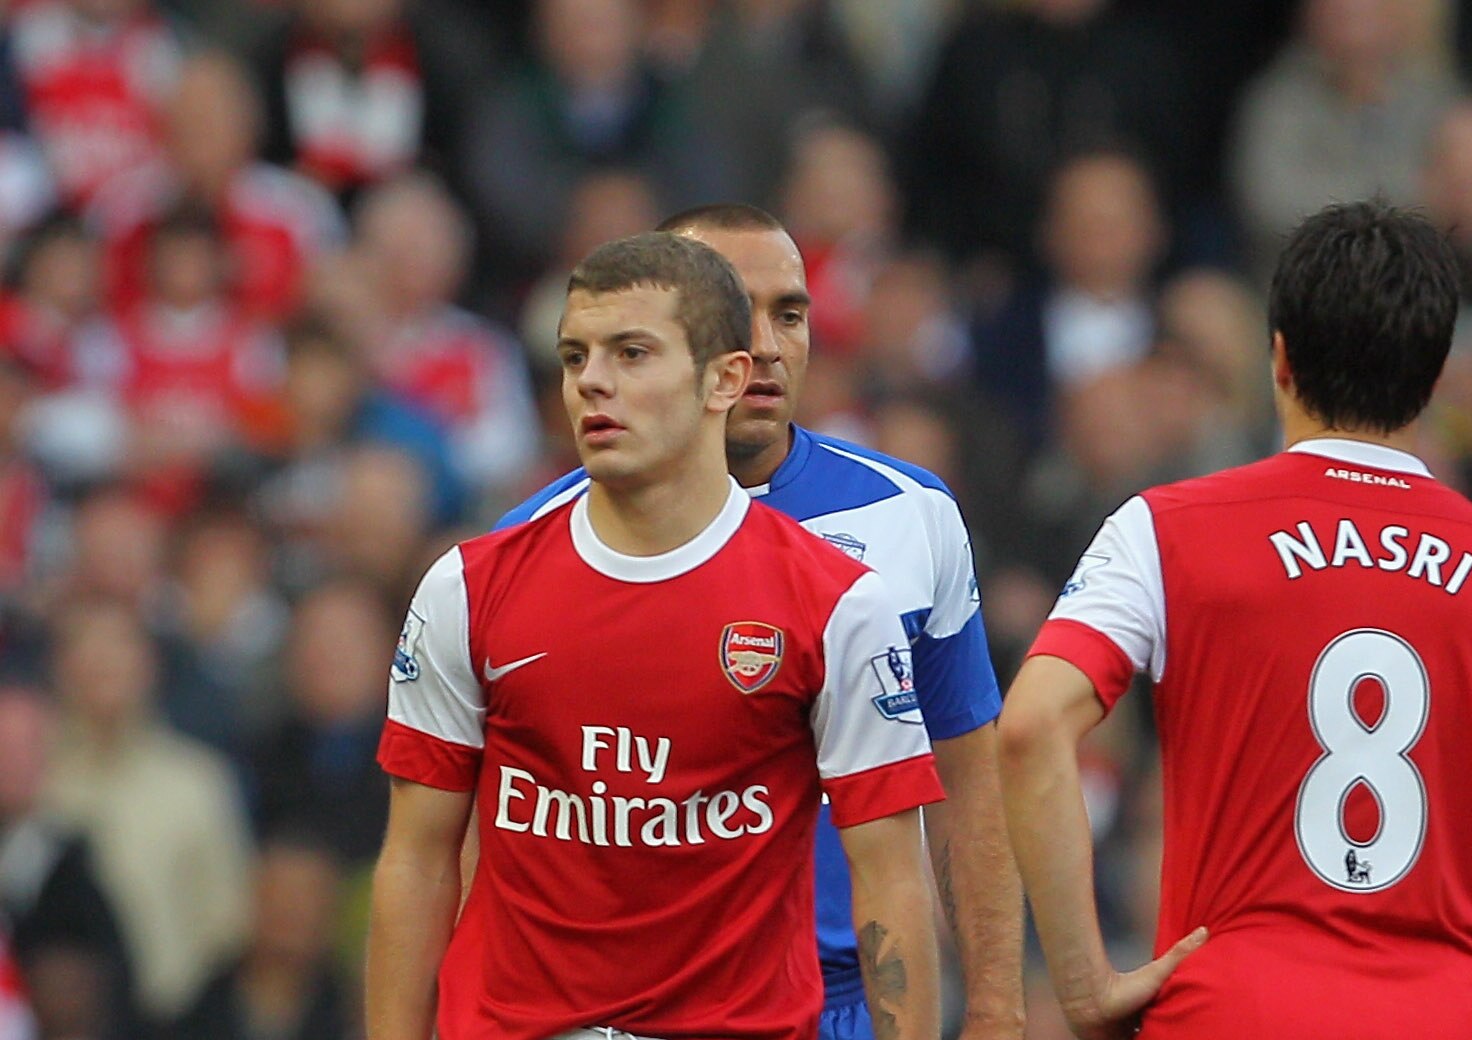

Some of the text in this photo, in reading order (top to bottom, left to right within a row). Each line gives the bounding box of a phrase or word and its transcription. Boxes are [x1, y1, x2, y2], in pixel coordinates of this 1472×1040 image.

[1323, 467, 1412, 490] ARSENAL
[730, 632, 775, 648] Arsenal
[581, 725, 671, 783] Fly
[1294, 627, 1430, 893] 8
[494, 765, 774, 847] Emirates
